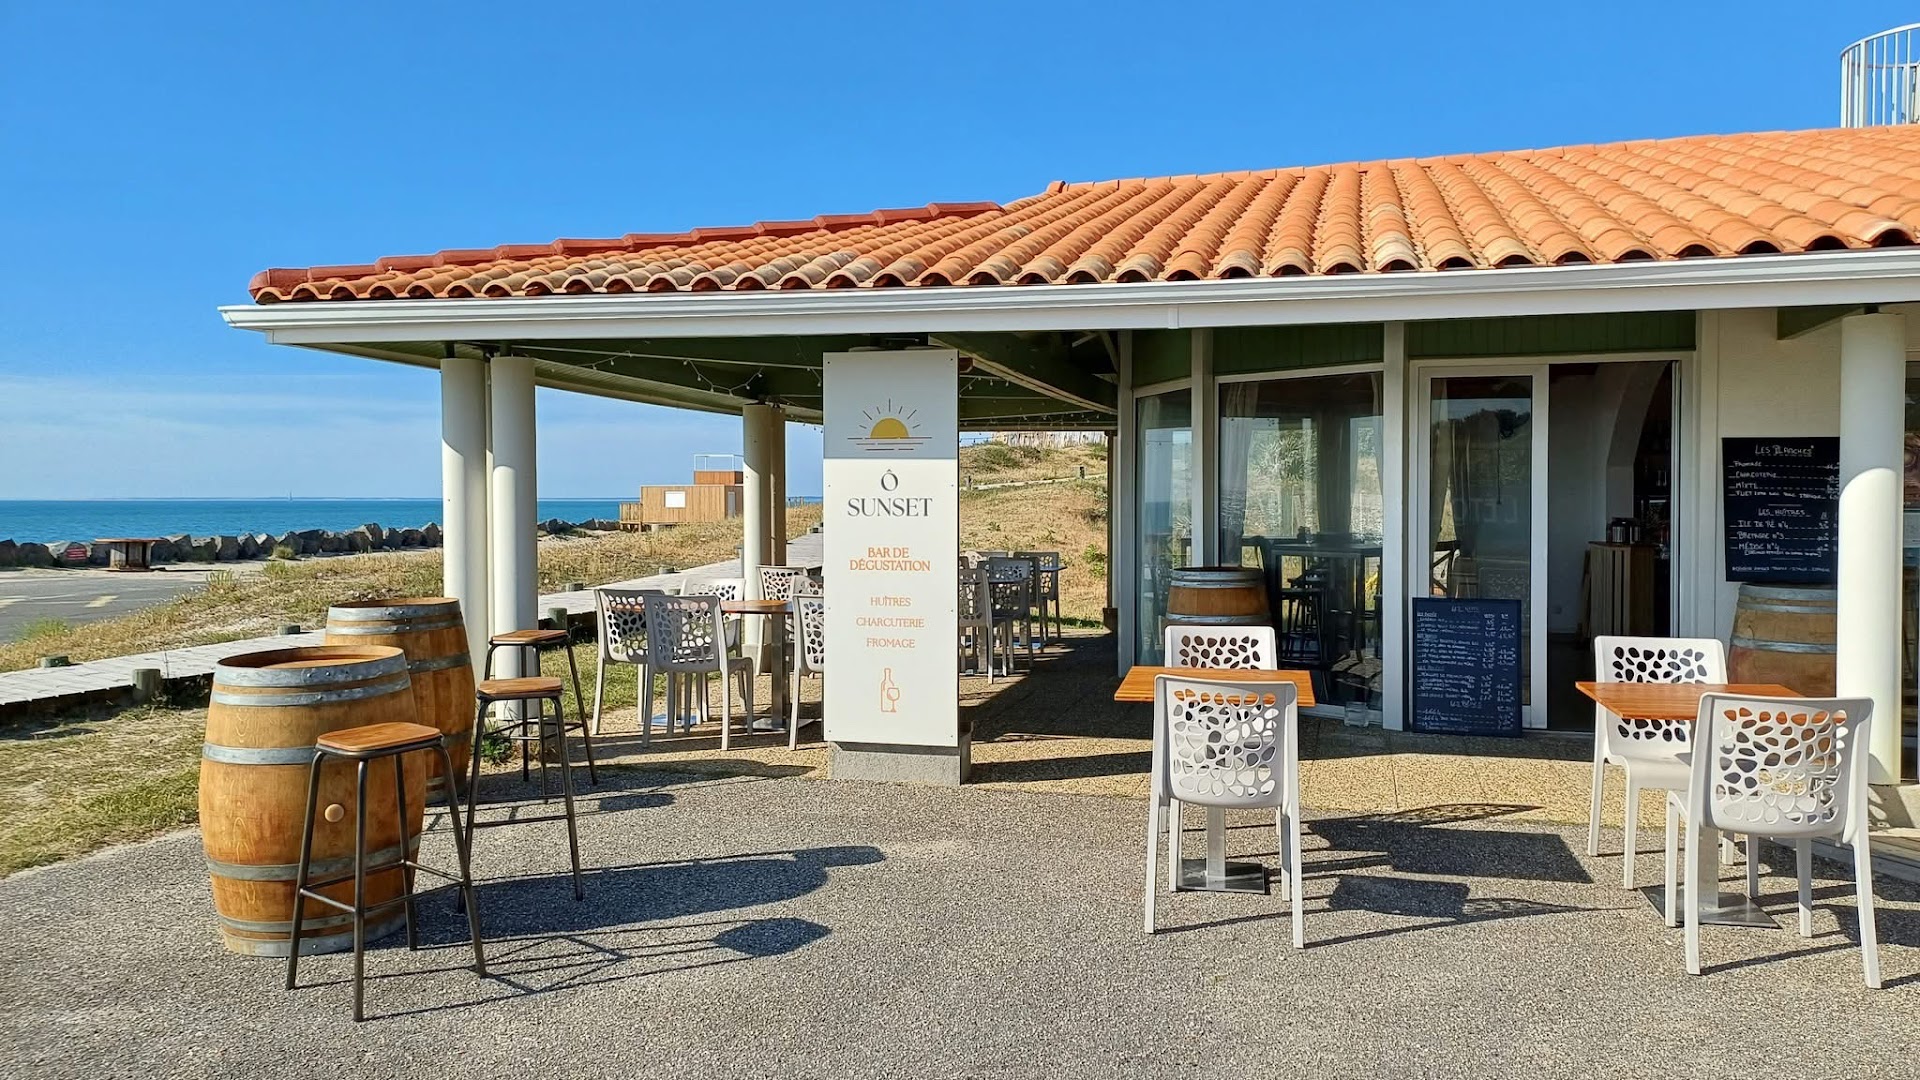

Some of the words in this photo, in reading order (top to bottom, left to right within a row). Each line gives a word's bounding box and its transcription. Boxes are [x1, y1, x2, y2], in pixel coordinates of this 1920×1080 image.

[1755, 444, 1771, 455] LES
[880, 468, 899, 492] Ô
[847, 497, 933, 517] SUNSET
[867, 546, 891, 558] BAR
[893, 547, 910, 559] DE
[849, 558, 931, 571] DÉGUSTATION
[870, 595, 912, 607] HUÎTRES
[856, 616, 925, 628] CHARCUTERIE
[866, 637, 916, 648] FROMAGE
